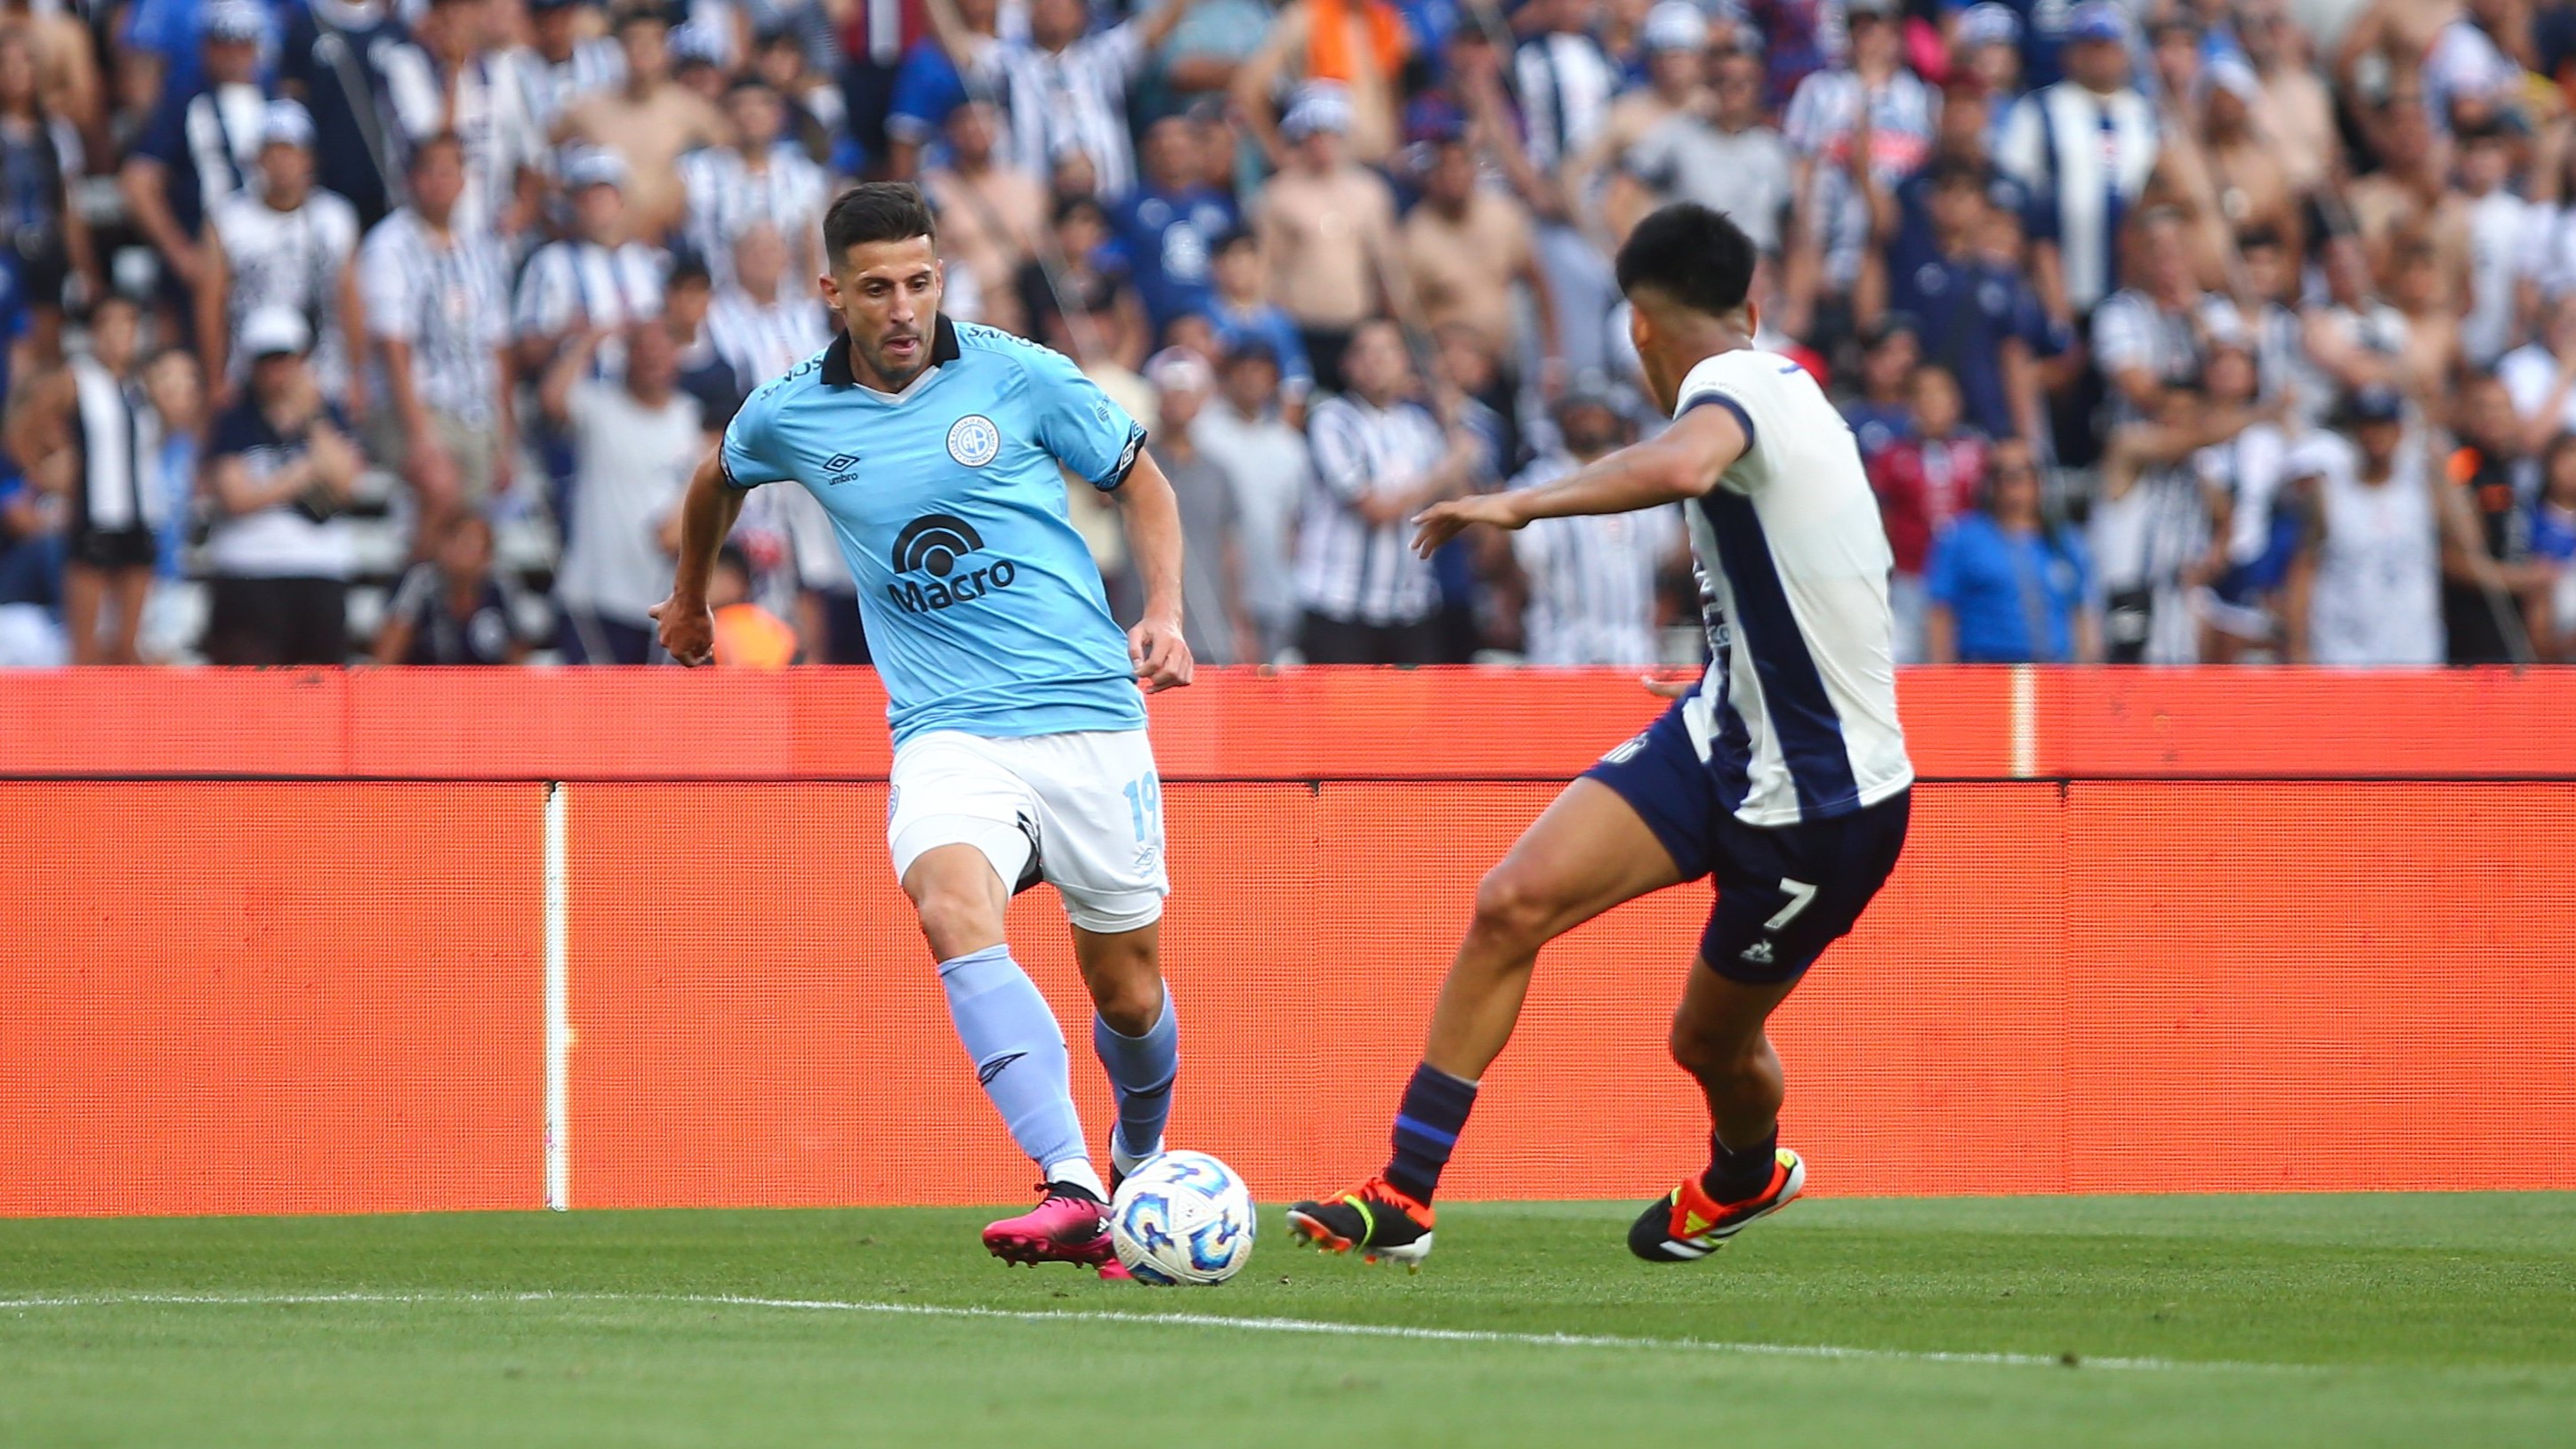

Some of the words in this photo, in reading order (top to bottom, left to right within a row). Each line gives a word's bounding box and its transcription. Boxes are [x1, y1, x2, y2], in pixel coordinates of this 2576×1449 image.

[828, 472, 859, 486] umbro
[886, 559, 1016, 614] Macro
[1122, 770, 1157, 843] 19
[1763, 876, 1818, 930] 7
